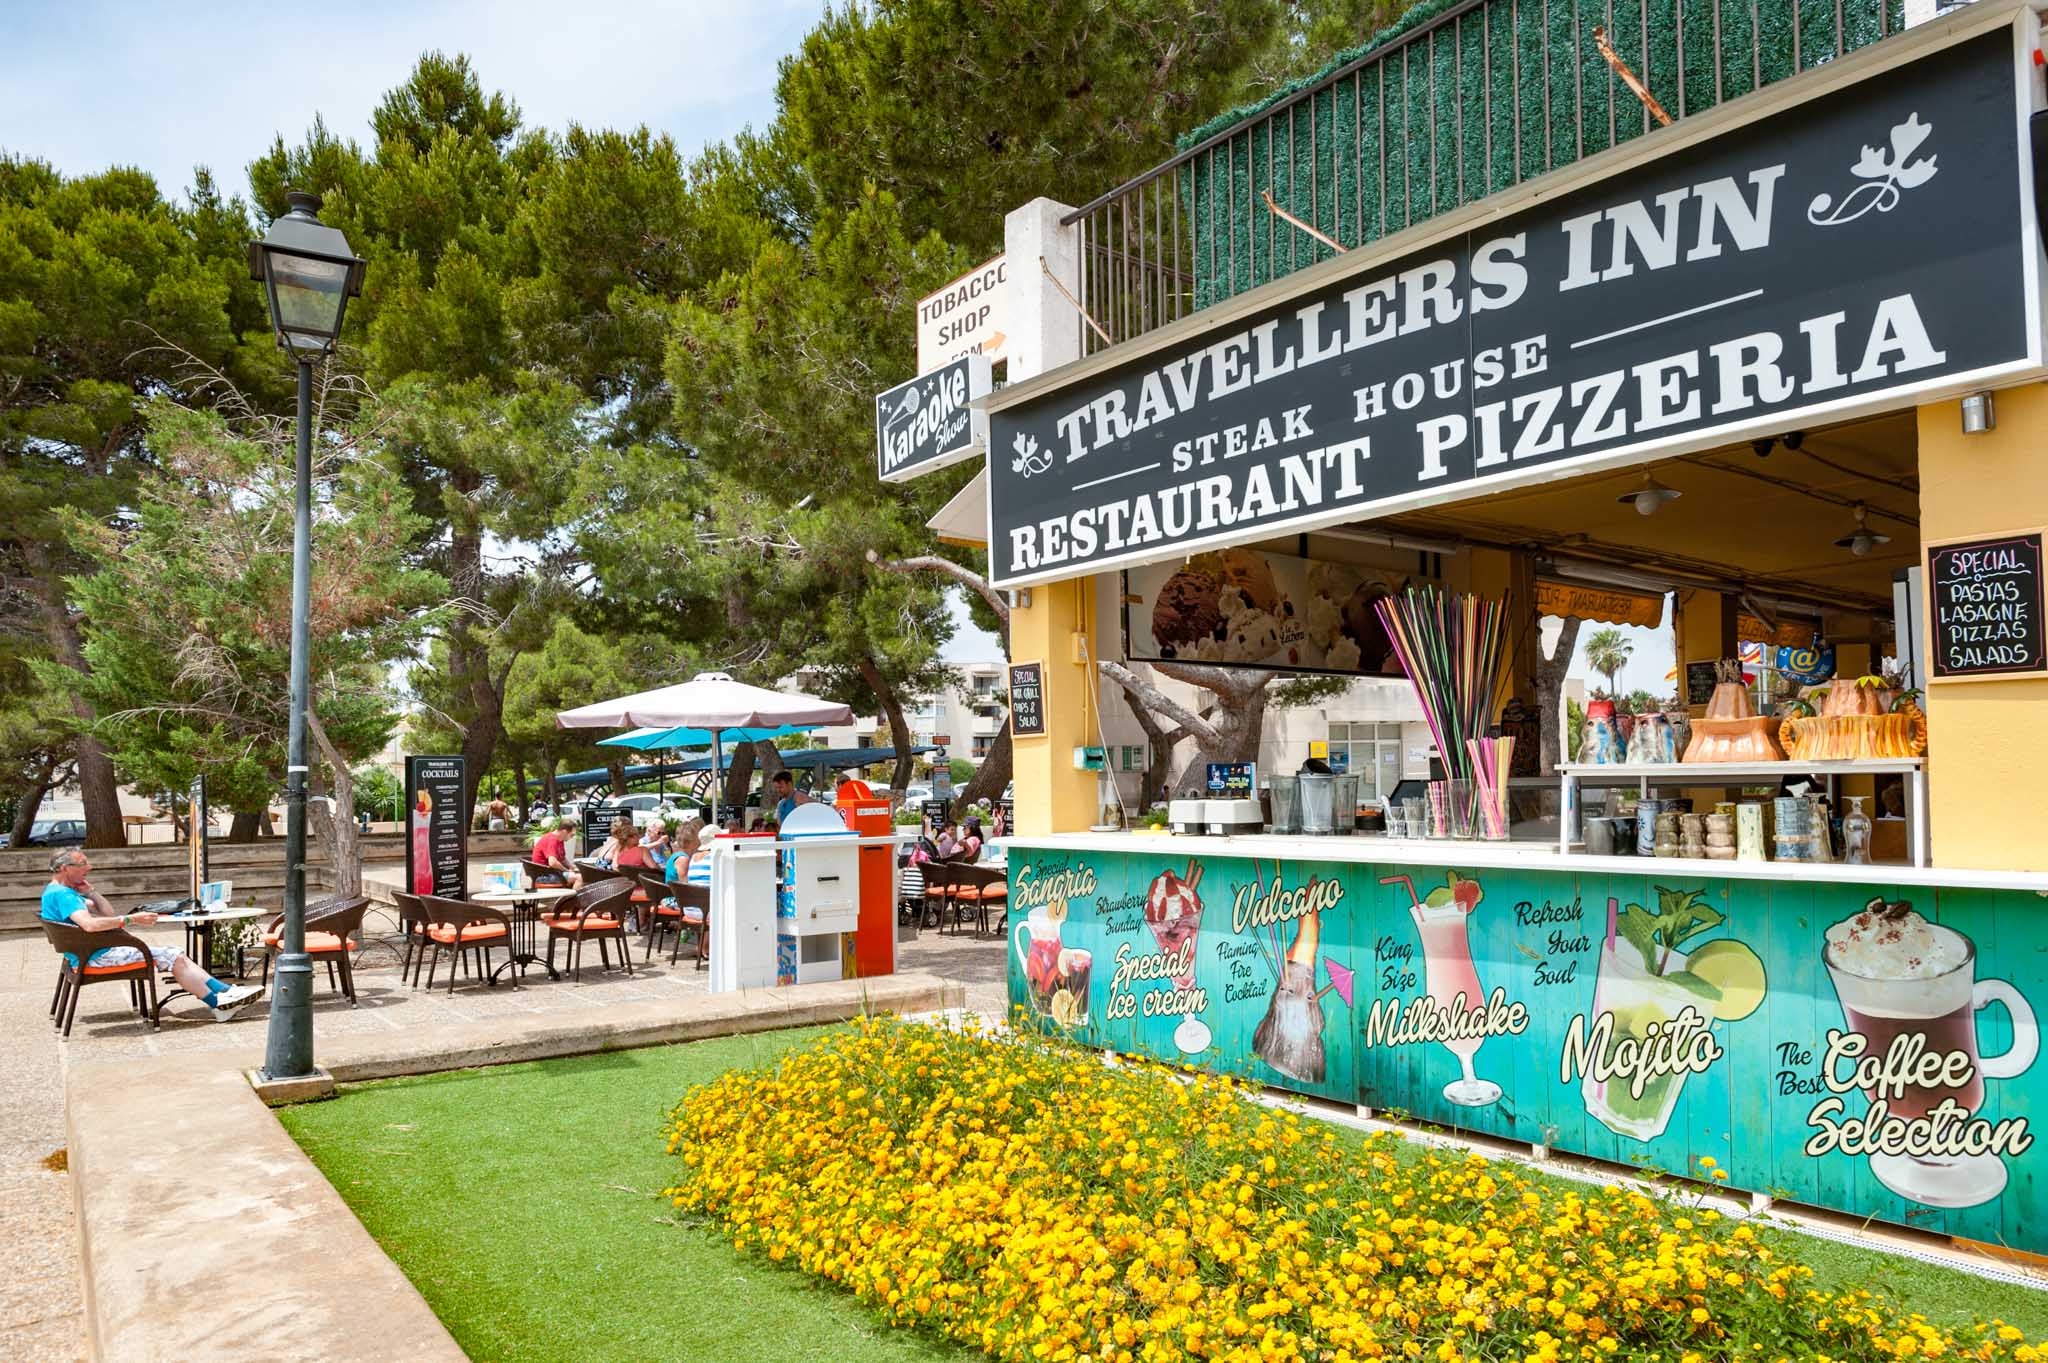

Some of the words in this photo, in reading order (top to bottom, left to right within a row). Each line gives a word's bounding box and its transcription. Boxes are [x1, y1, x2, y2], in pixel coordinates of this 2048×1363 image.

[938, 304, 991, 347] SHOP
[1056, 232, 1528, 464] TRAVELLERS
[1559, 164, 1786, 292] INN
[1172, 404, 1314, 473] STEAK
[1353, 334, 1548, 423] HOUSE
[935, 411, 969, 455] Show
[1009, 437, 1371, 572] RESTAURANT
[1416, 293, 1947, 483] PIZZERIA
[1950, 549, 2026, 576] SPECIAL
[1951, 581, 2020, 603] PASTAS
[1940, 602, 2028, 624] LASAGNE
[1948, 621, 2027, 644] PIZZAS
[1950, 644, 2029, 668] SALADS
[421, 769, 459, 779] COCKTAILS
[1035, 855, 1070, 880] Special
[1014, 861, 1098, 915] Sangria
[1095, 892, 1148, 915] Strawberry
[1231, 876, 1345, 935] Vulcano
[1513, 897, 1585, 928] Refresh
[1105, 914, 1142, 936] Sunday
[1216, 940, 1259, 961] Flaming
[1374, 936, 1414, 964] King
[1546, 930, 1592, 956] Your
[1115, 936, 1192, 992] Special
[1230, 960, 1251, 980] Fire
[1533, 961, 1577, 986] Soul
[1225, 978, 1268, 1003] Cocktail
[1381, 966, 1417, 992] Size
[1107, 979, 1137, 1021] Ice
[1142, 987, 1208, 1018] cream
[1366, 986, 1529, 1050] Milkshake
[1560, 1004, 1723, 1100] Mojito
[1776, 1041, 1813, 1068] The
[1823, 1028, 1975, 1100] Coffee
[1776, 1070, 1829, 1096] Best
[1804, 1096, 2035, 1157] Selection
